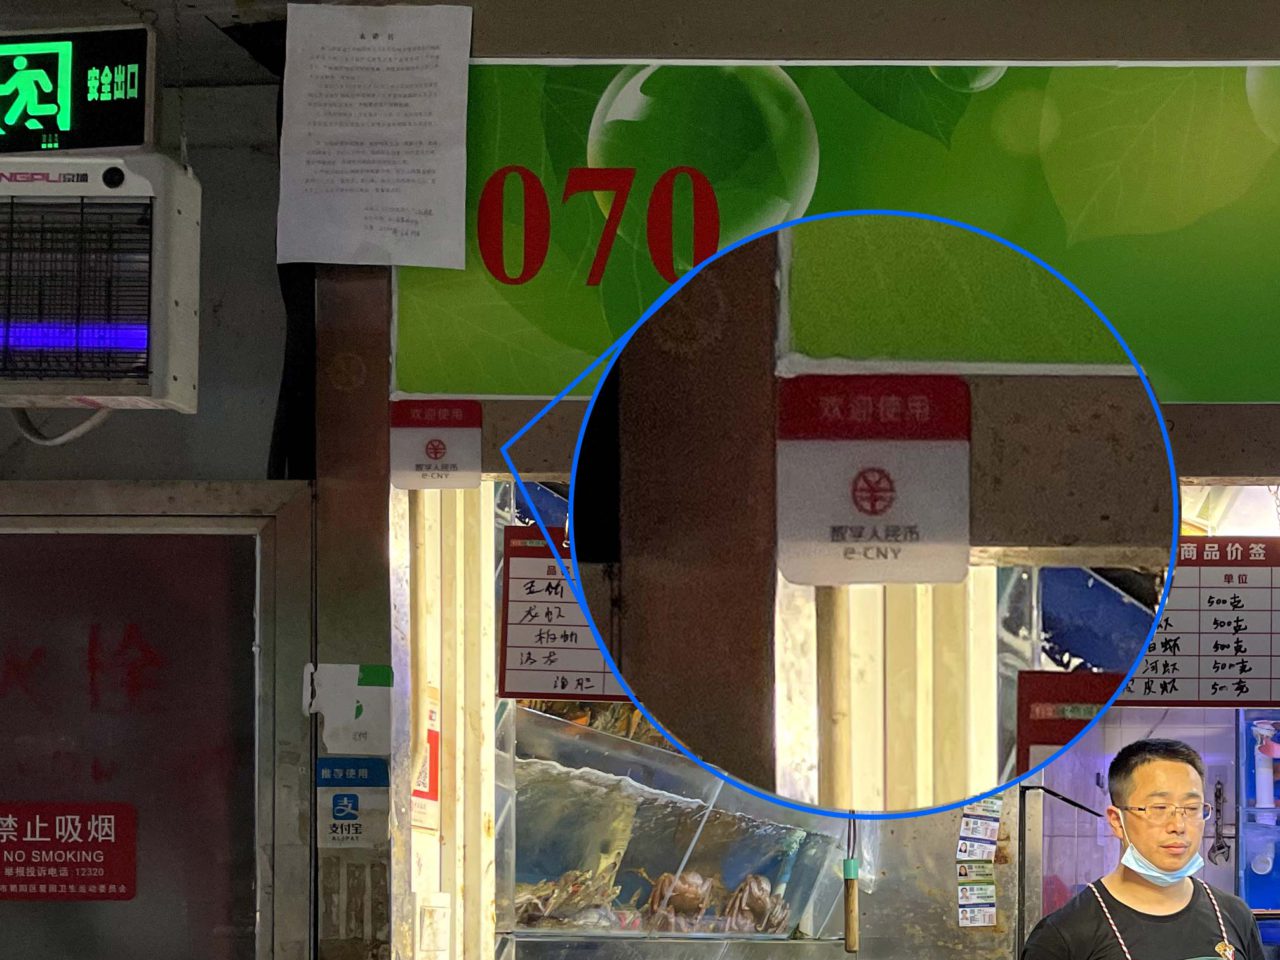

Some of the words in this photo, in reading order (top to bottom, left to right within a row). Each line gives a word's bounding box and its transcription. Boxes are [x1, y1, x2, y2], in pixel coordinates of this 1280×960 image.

[87, 64, 139, 101] 安全出口
[477, 165, 720, 286] 070
[821, 395, 931, 424] 欢迎使用
[415, 464, 458, 472] 数字人民币
[830, 525, 920, 543] 数字人民币
[843, 548, 902, 560] e-CNY
[1180, 543, 1266, 561] 商品价签
[1224, 573, 1248, 584] 单位
[1207, 594, 1244, 610] 500克
[1212, 616, 1248, 635] 500克
[1212, 637, 1248, 656] 500克
[1141, 659, 1180, 676] 河虾
[321, 768, 369, 779] 推荐使用
[0, 814, 116, 843] 禁止吸烟
[328, 823, 363, 835] 支付宝
[3, 850, 26, 862] NO
[31, 850, 105, 862] SMOKING
[75, 867, 105, 877] 12320
